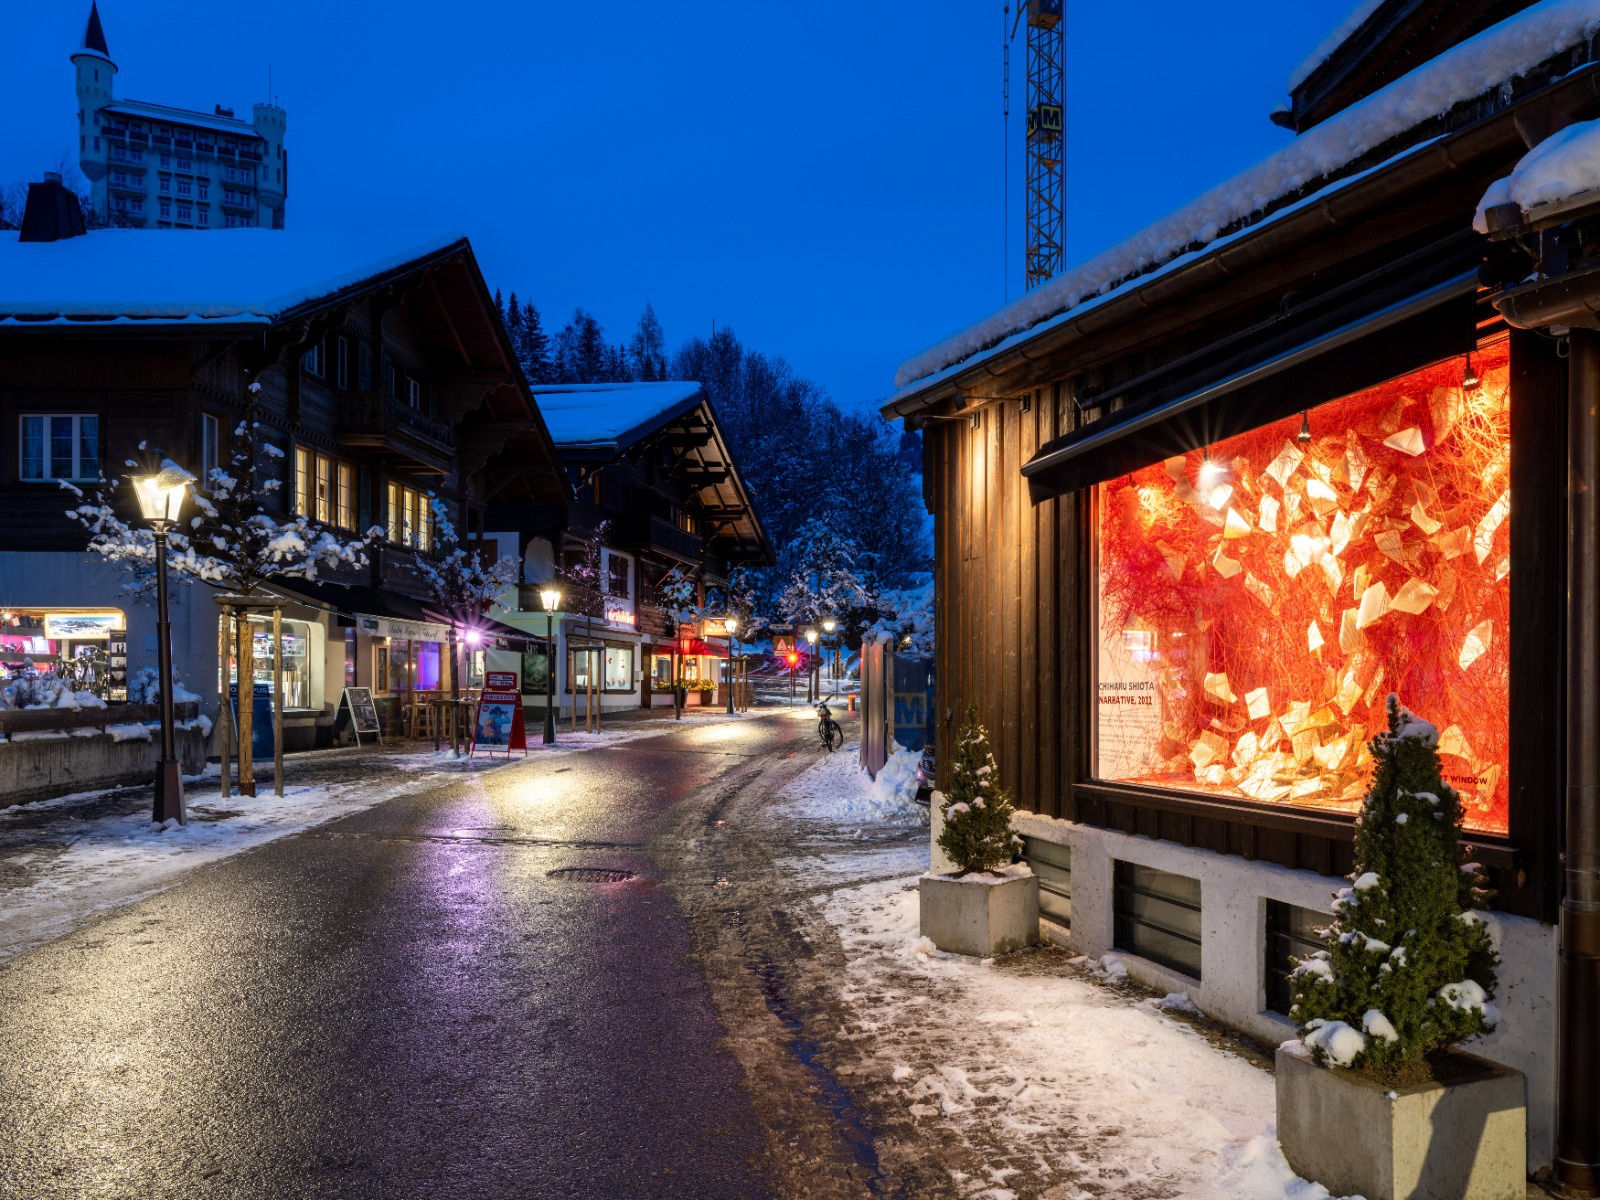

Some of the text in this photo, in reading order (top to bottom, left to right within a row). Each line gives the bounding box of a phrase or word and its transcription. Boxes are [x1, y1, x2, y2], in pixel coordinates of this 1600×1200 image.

[1099, 681, 1154, 691] CHIHARU SHIOTA
[1450, 775, 1487, 785] WINDOW
